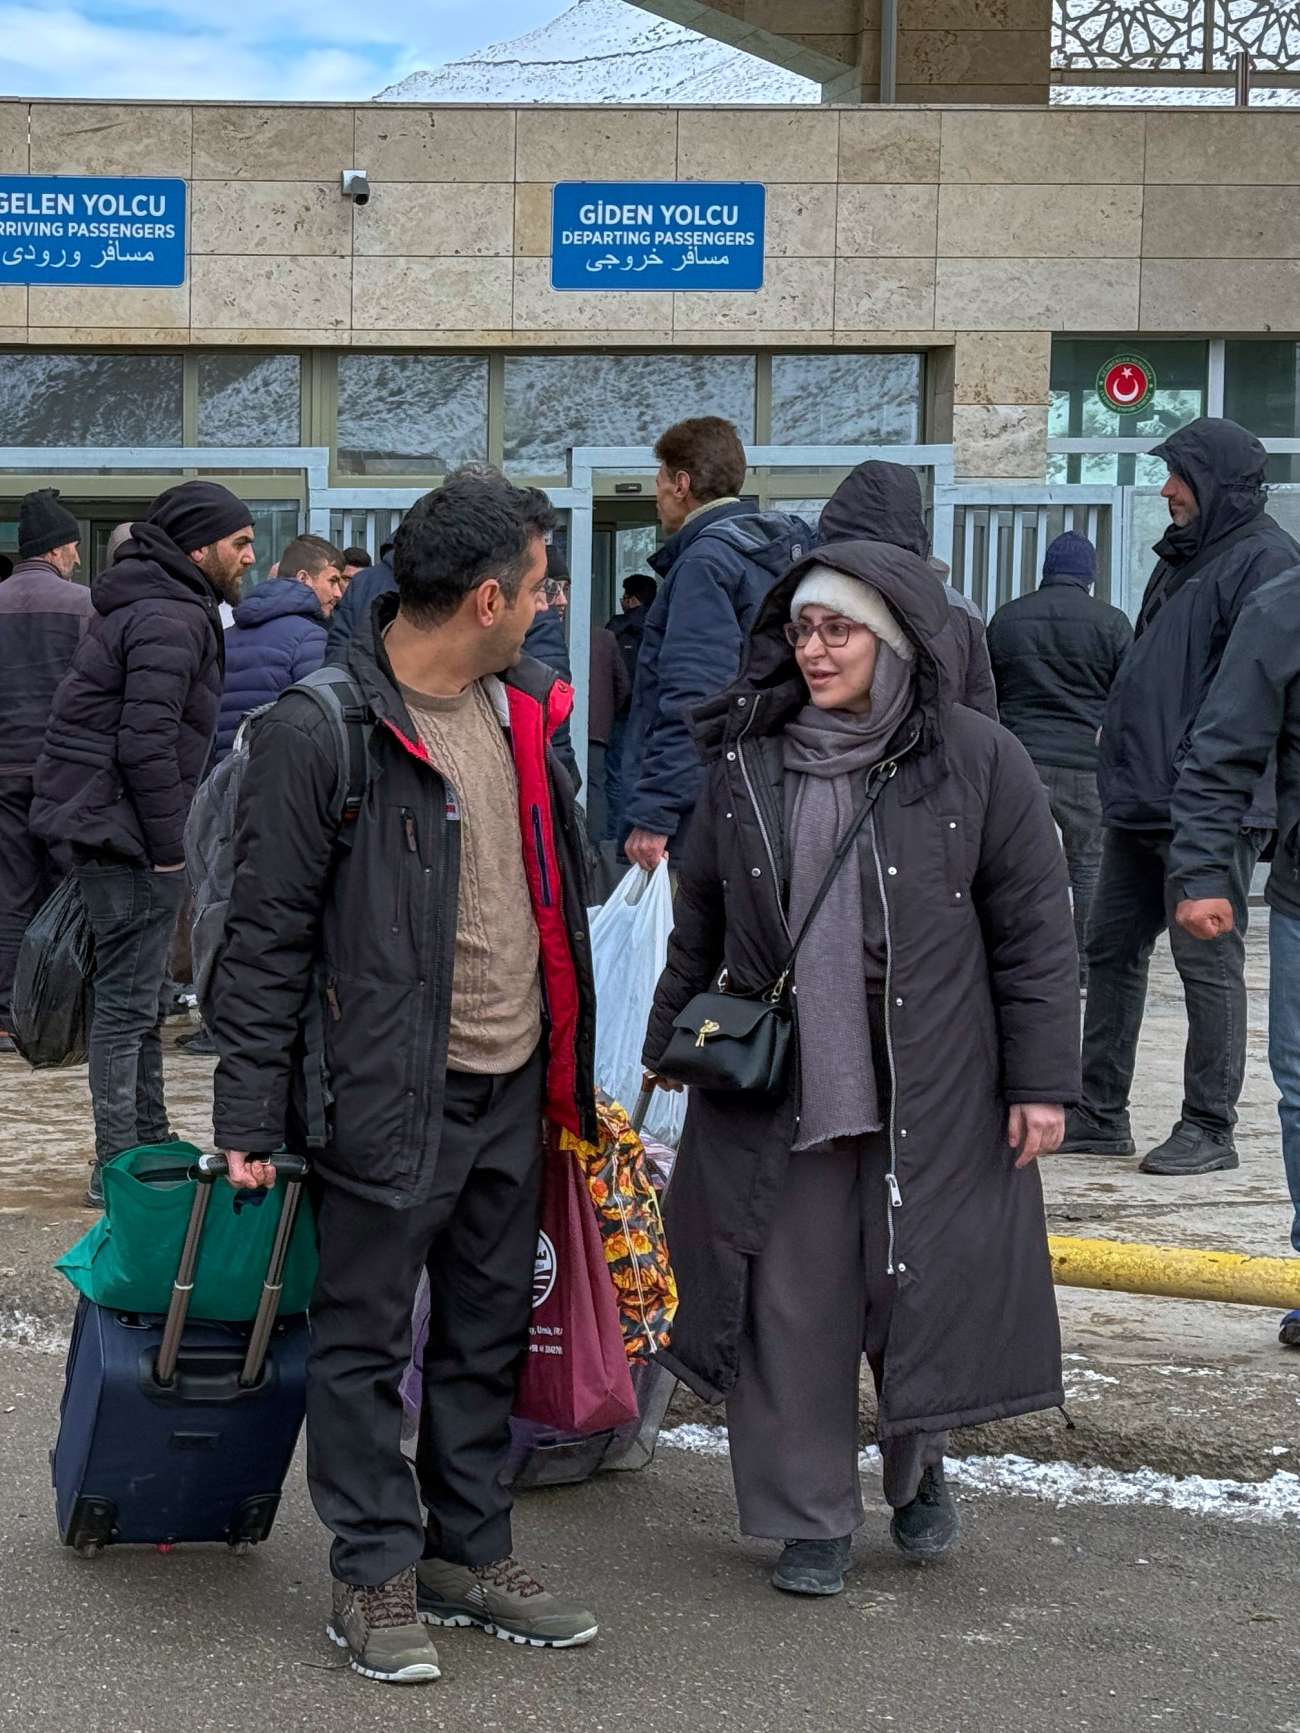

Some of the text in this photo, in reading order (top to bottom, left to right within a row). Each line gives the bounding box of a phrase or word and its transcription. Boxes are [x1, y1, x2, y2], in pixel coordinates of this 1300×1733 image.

[81, 194, 166, 217] YOLCU
[579, 200, 739, 226] GİDEN YOLCU
[68, 222, 175, 239] PASSENGERS
[562, 230, 755, 246] DEPARTING PASSENGERS
[2, 239, 155, 268] مسافر ورودی
[585, 245, 729, 271] مسافر خروجی
